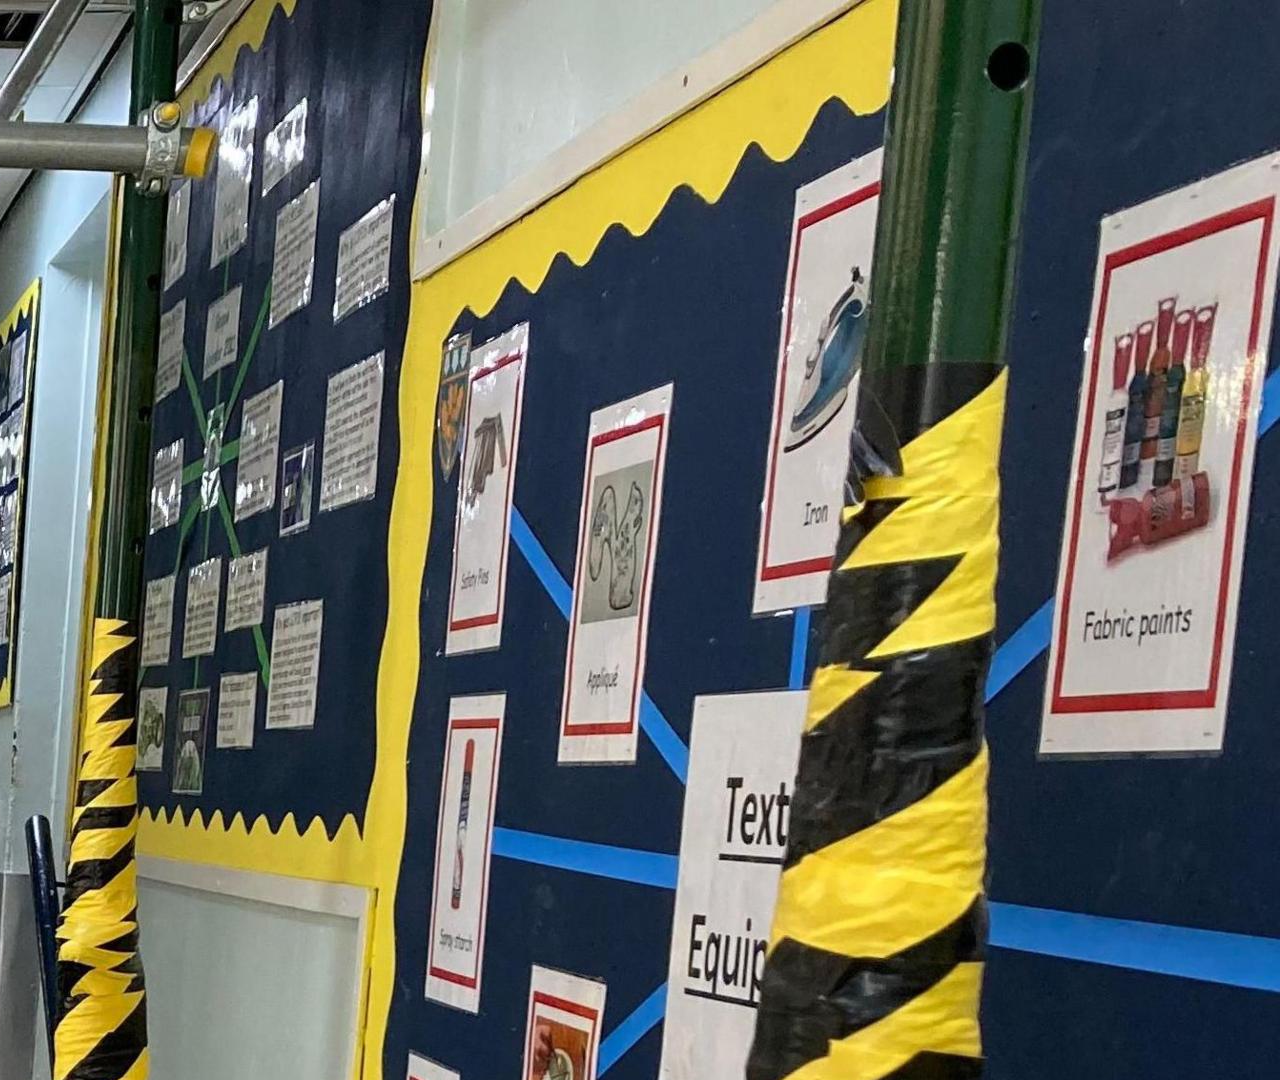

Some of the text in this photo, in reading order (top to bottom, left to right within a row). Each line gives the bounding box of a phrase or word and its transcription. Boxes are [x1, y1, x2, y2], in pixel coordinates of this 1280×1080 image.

[803, 502, 828, 527] Iron
[1083, 604, 1193, 647] Fabric paints
[586, 664, 620, 696] Appliqué
